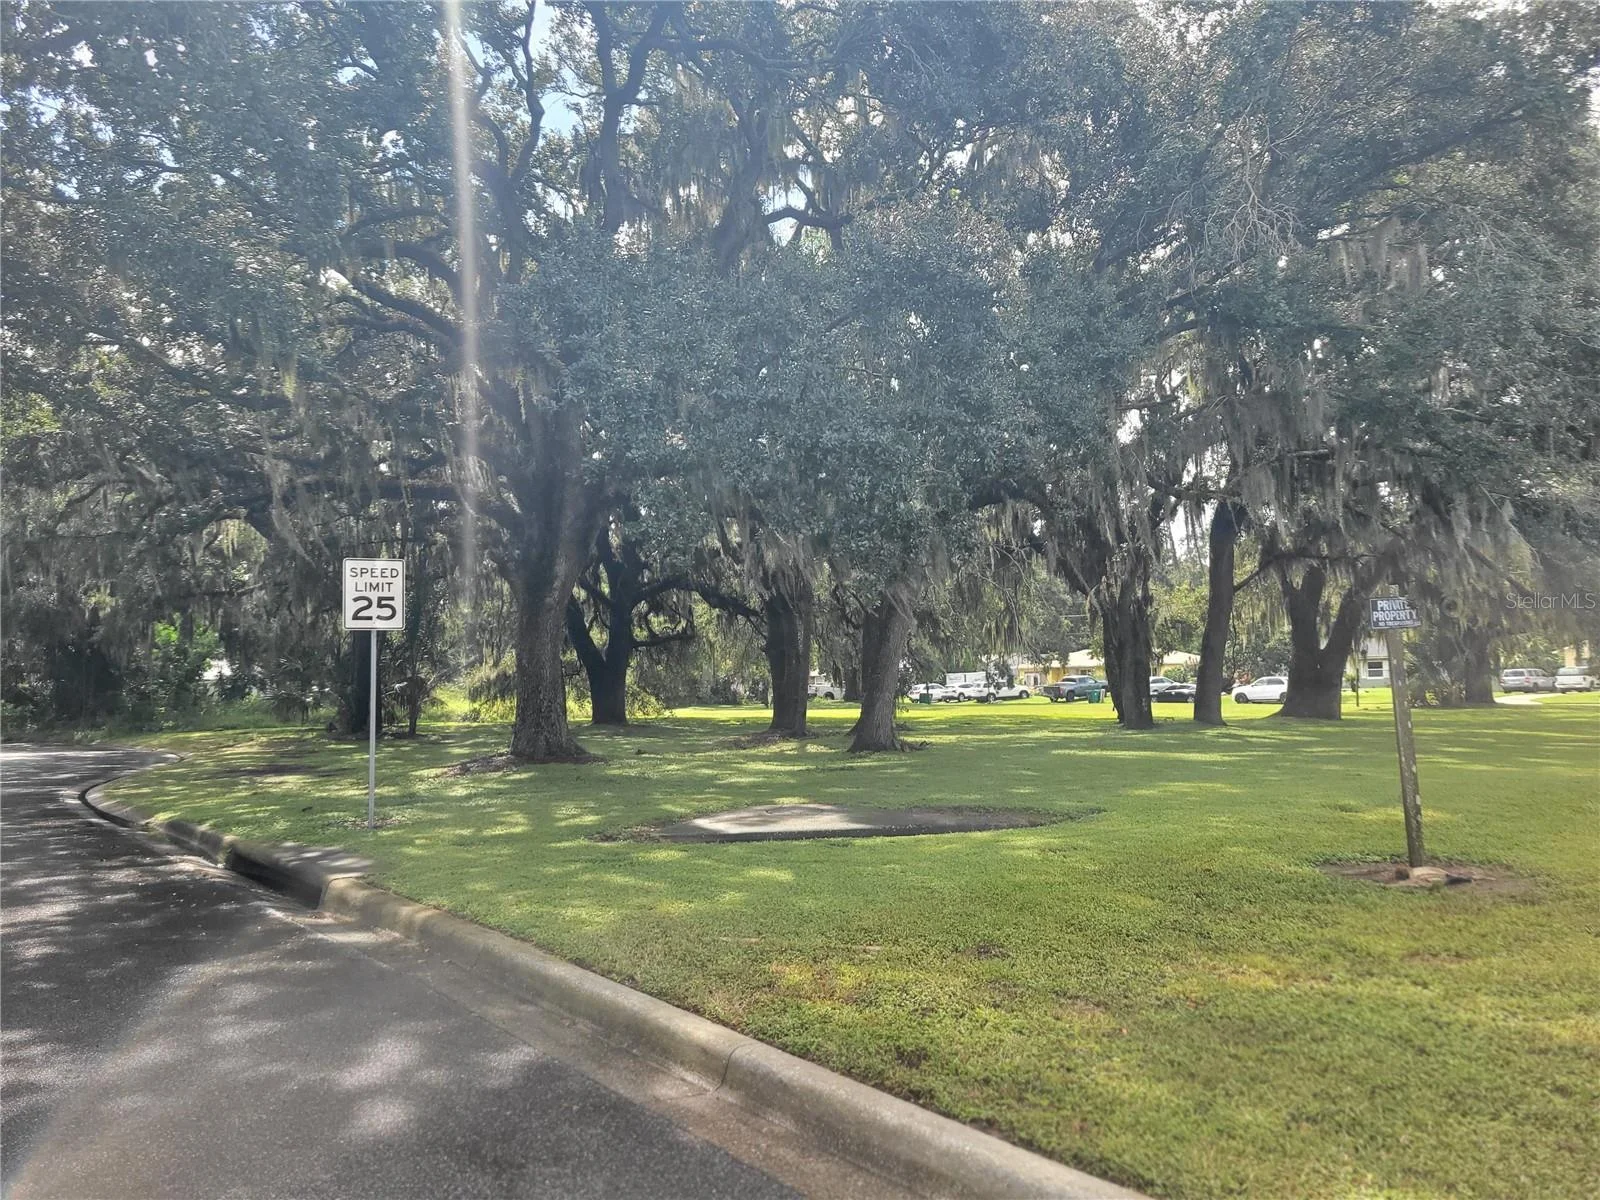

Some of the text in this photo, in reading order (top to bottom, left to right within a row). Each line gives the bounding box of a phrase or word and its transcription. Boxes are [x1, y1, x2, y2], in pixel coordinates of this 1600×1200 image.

[350, 567, 399, 578] SPEED
[355, 582, 393, 592] LIMIT
[352, 596, 397, 621] 25
[1373, 609, 1417, 621] PROPERTY
